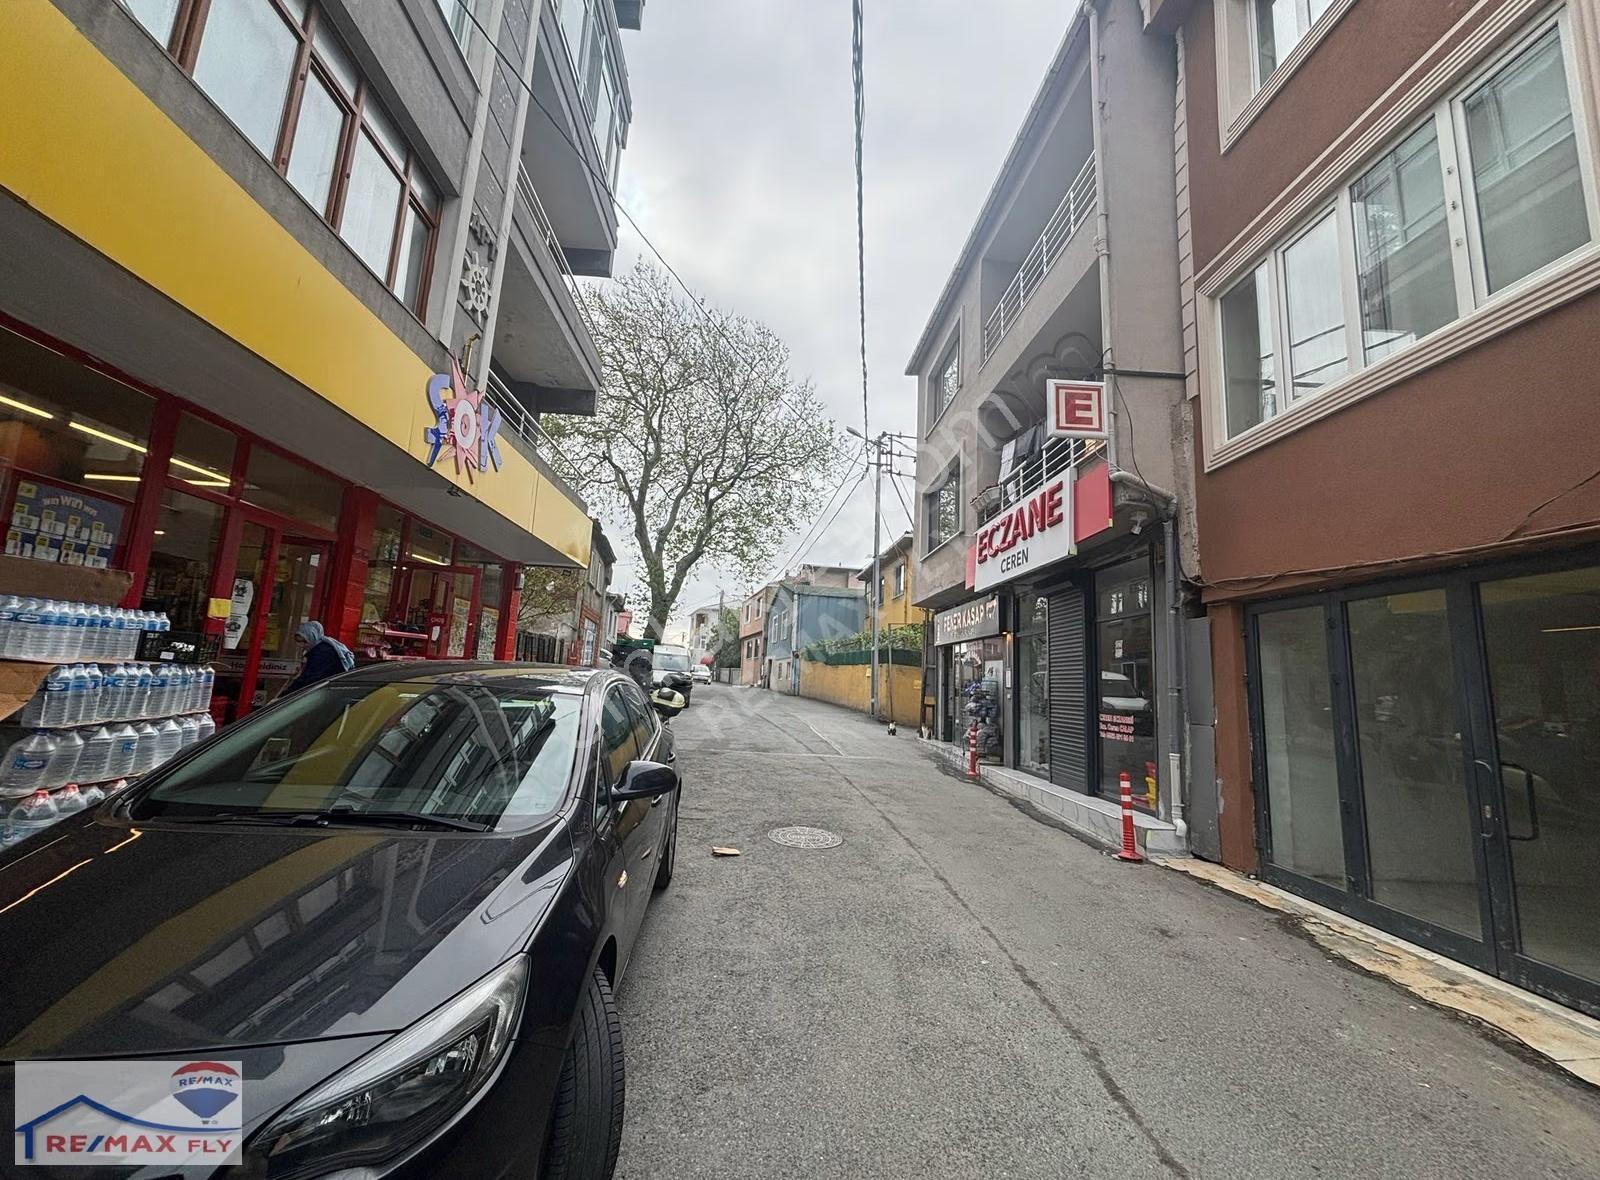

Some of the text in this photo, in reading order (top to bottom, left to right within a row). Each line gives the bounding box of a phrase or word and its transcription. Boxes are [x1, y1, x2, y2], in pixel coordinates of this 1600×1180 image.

[1065, 392, 1093, 425] E
[977, 481, 1064, 565] ECZANE
[1000, 547, 1030, 574] CEREN
[962, 604, 985, 628] KASAP
